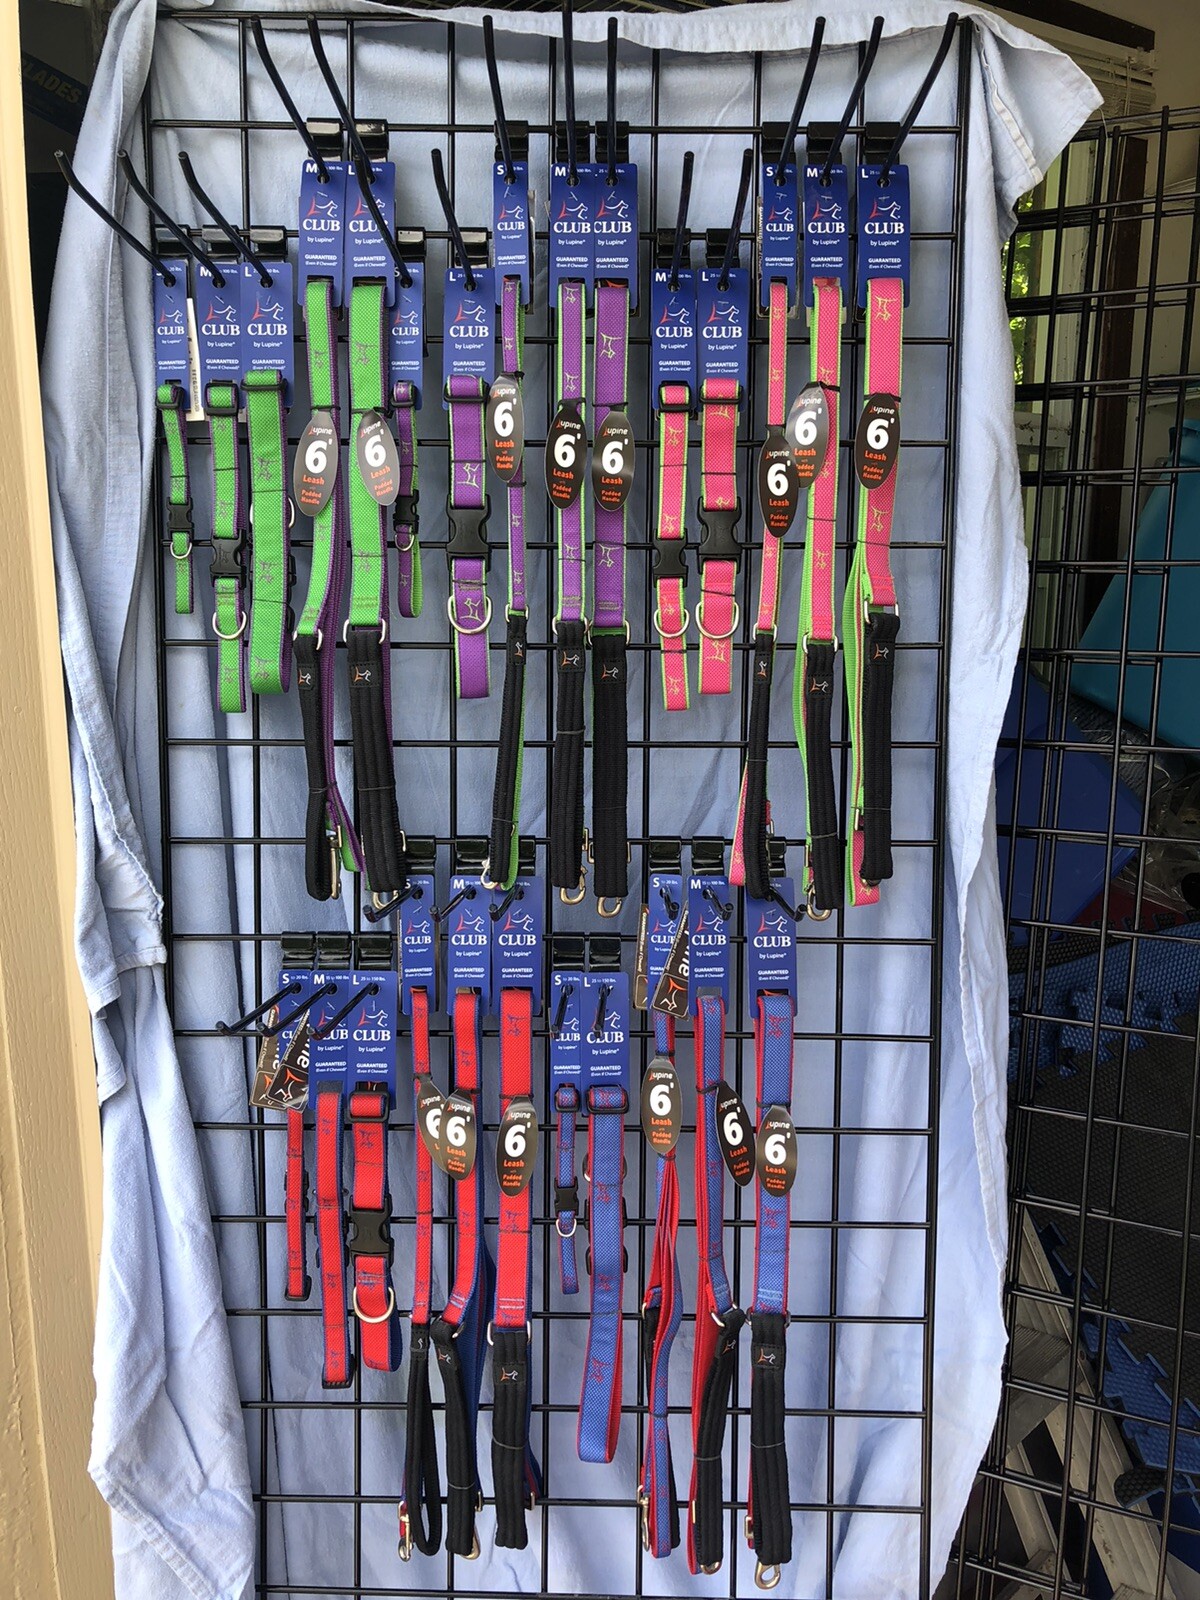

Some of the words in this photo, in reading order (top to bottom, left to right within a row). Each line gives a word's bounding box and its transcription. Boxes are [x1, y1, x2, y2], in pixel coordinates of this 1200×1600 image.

[306, 163, 317, 173] M
[348, 165, 355, 175] L
[497, 165, 504, 174] S
[555, 167, 566, 176] M
[766, 167, 773, 176] S
[807, 168, 818, 177] M
[862, 169, 868, 178] L
[303, 219, 340, 231] CLUB
[349, 220, 388, 232] CLU
[497, 222, 525, 231] CLUB
[554, 222, 591, 233] CLUB
[594, 221, 632, 233] CLUB
[766, 223, 794, 232] CLUB
[808, 222, 845, 233] CLUB
[864, 222, 904, 234] CLUB
[200, 267, 212, 277] M
[245, 267, 252, 277] L
[450, 272, 456, 281] L
[655, 272, 666, 281] M
[702, 272, 709, 281] L
[157, 326, 184, 336] CLUB
[202, 324, 240, 336] CLUB
[247, 324, 287, 336] CLUB
[392, 327, 419, 336] CLUB
[450, 326, 489, 337] CLUB
[656, 326, 693, 337] CLUB
[703, 326, 742, 338] CLUB
[495, 440, 514, 448] Leash
[794, 448, 816, 456] Leash
[865, 450, 886, 461] Leash
[371, 466, 390, 478] Leash
[553, 468, 574, 479] Leash
[303, 475, 324, 485] Leash
[454, 879, 464, 889] M
[653, 877, 660, 888] S
[691, 880, 701, 889] M
[404, 936, 431, 944] CLUB
[452, 934, 487, 946] CLUB
[499, 934, 536, 946] CLUB
[692, 935, 726, 945] CLUB
[754, 936, 791, 947] CLUB
[282, 974, 289, 984] S
[314, 974, 324, 984] M
[353, 975, 359, 985] L
[555, 975, 561, 985] S
[584, 977, 590, 987] L
[320, 1030, 348, 1040] LUB
[353, 1030, 391, 1040] CLUB
[652, 1118, 672, 1126] Leash
[447, 1146, 466, 1156] Leash
[730, 1146, 748, 1158] Leash
[765, 1166, 786, 1174] Leash
